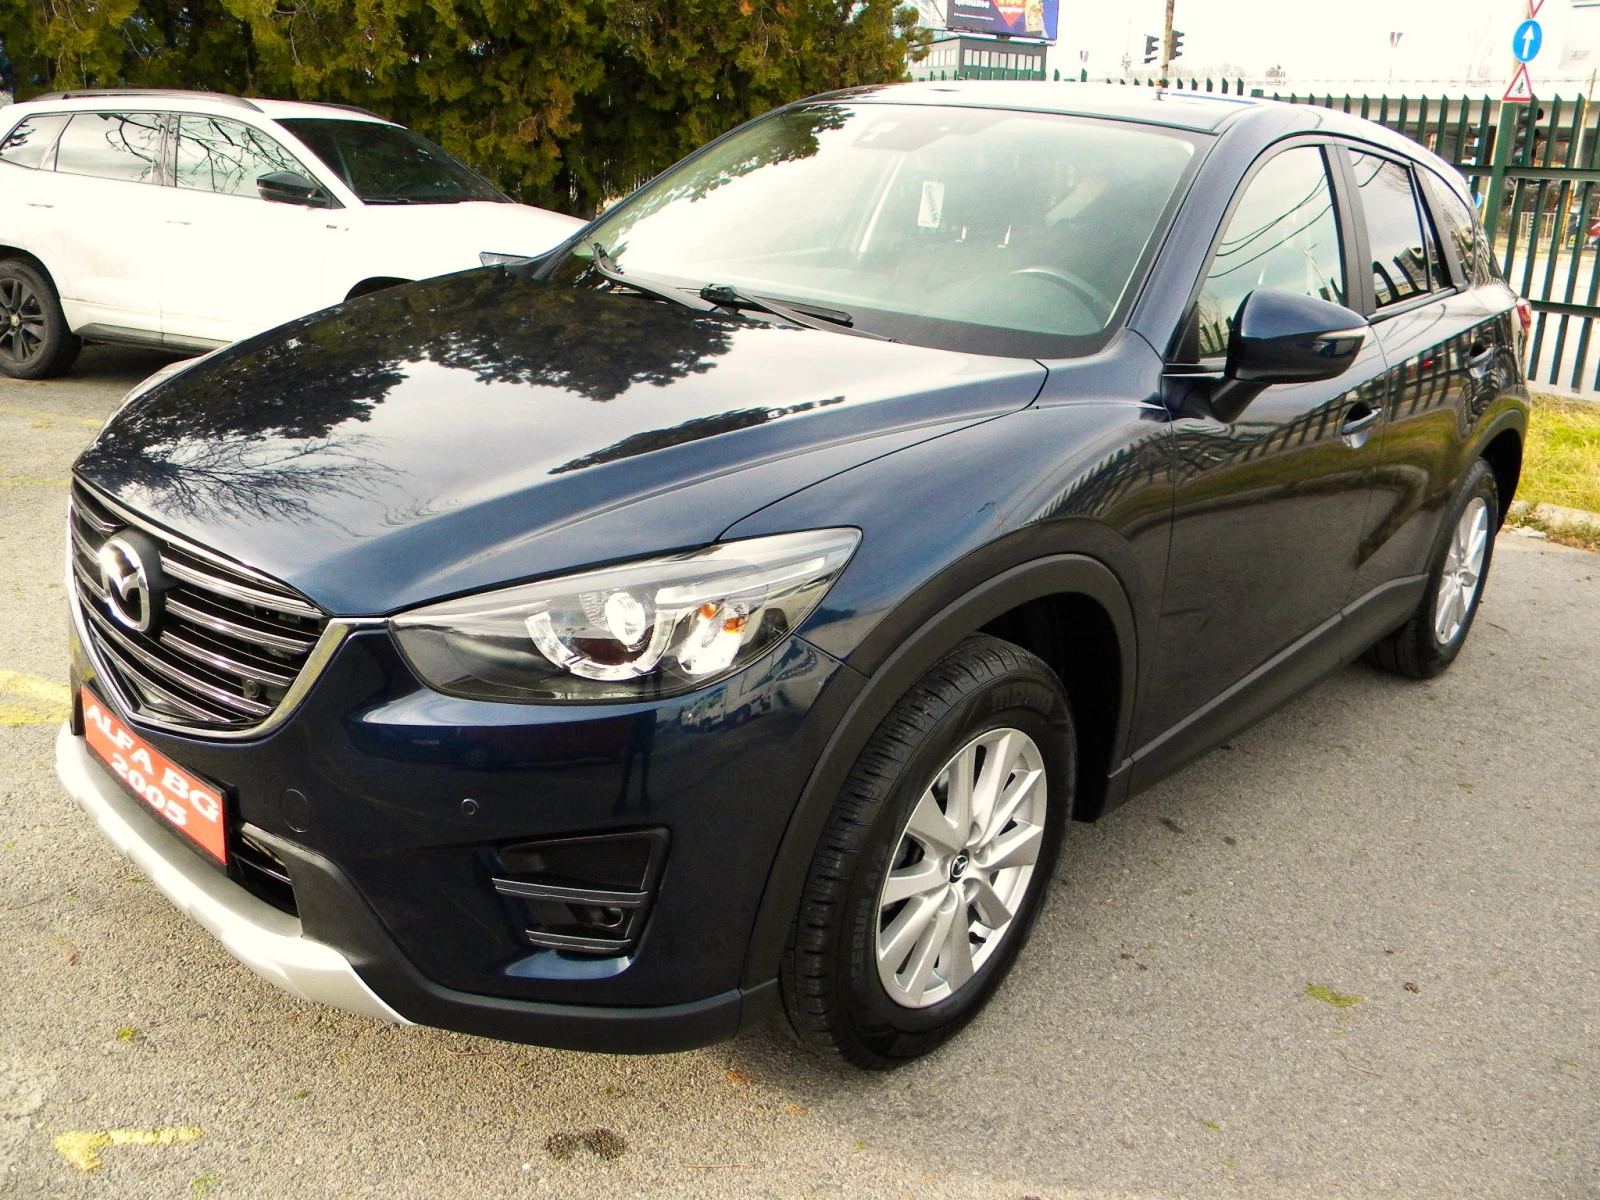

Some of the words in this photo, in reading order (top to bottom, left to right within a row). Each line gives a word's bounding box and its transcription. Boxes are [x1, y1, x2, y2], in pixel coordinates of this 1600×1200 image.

[86, 704, 154, 775] ALFA
[161, 767, 220, 823] BG
[111, 753, 188, 826] 2005
